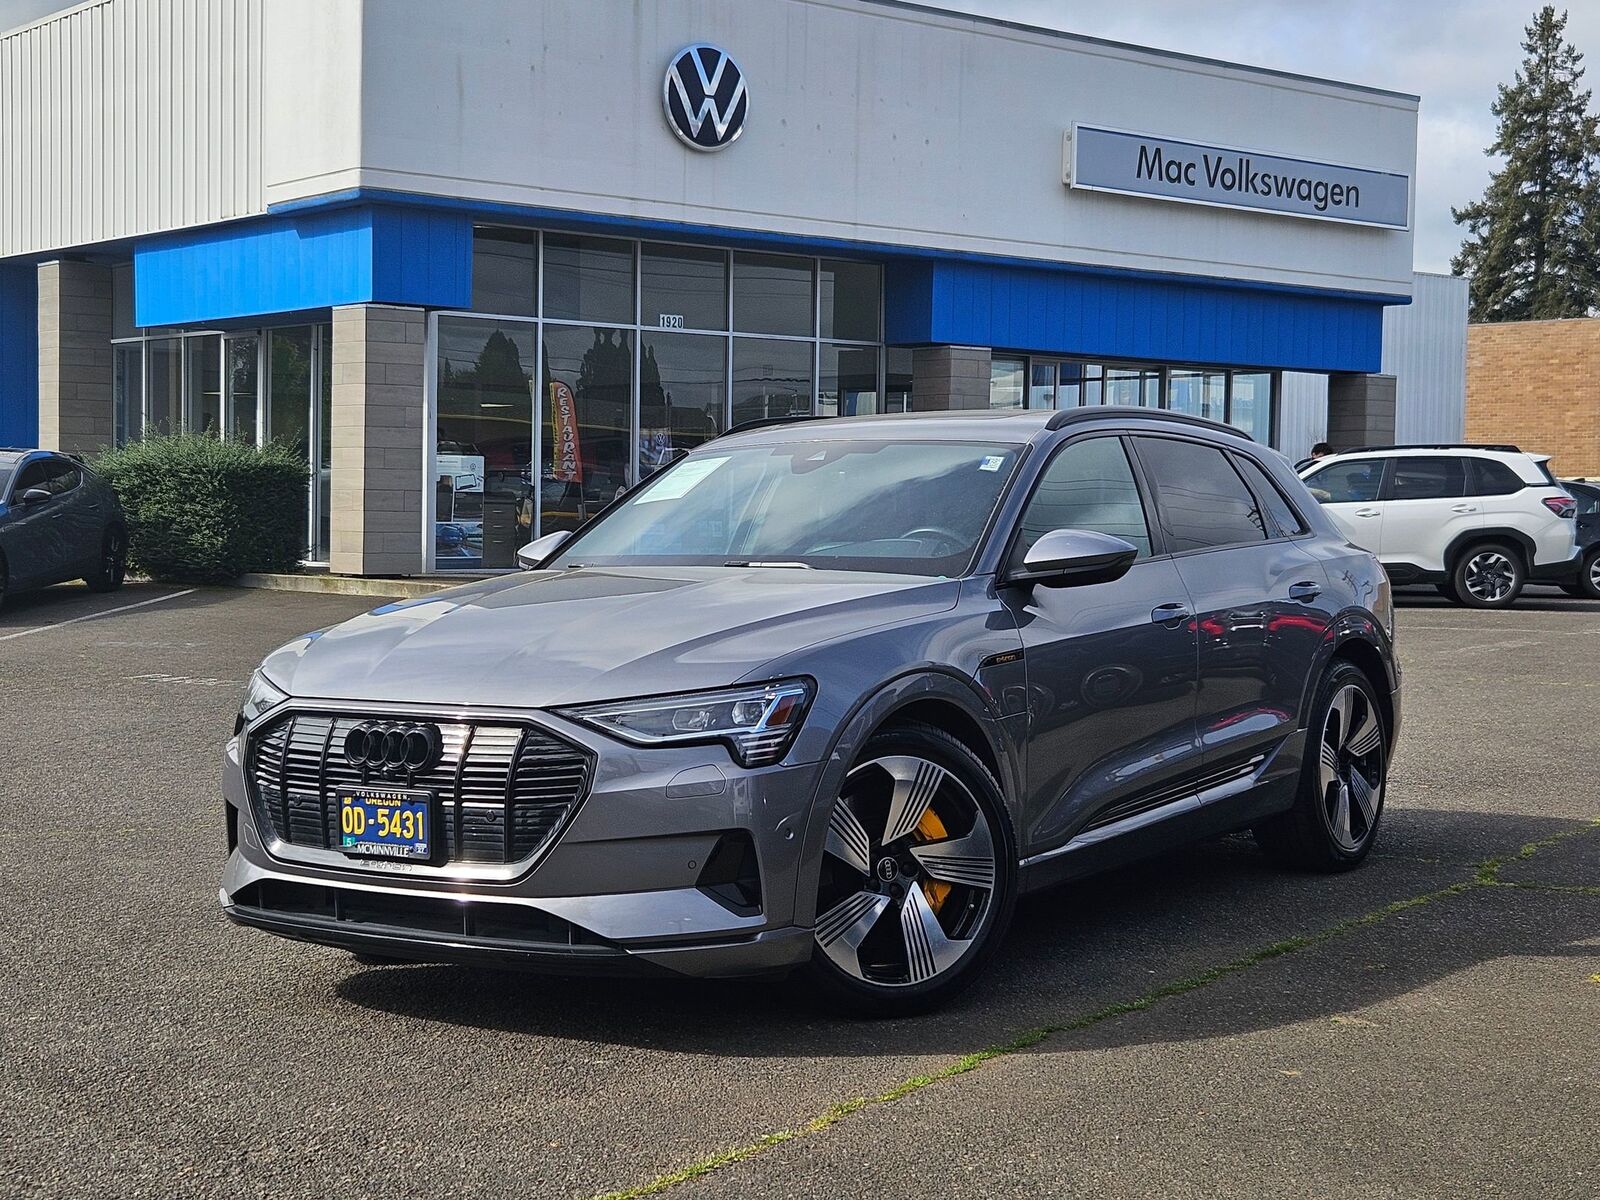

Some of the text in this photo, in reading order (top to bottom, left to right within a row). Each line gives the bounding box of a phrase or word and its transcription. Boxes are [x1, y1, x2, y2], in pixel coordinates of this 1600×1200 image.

[1135, 145, 1361, 212] Mac Volkswagen
[661, 316, 683, 329] 1920
[557, 387, 577, 480] RESTAURANT
[355, 791, 408, 800] VOLKSWAGEN
